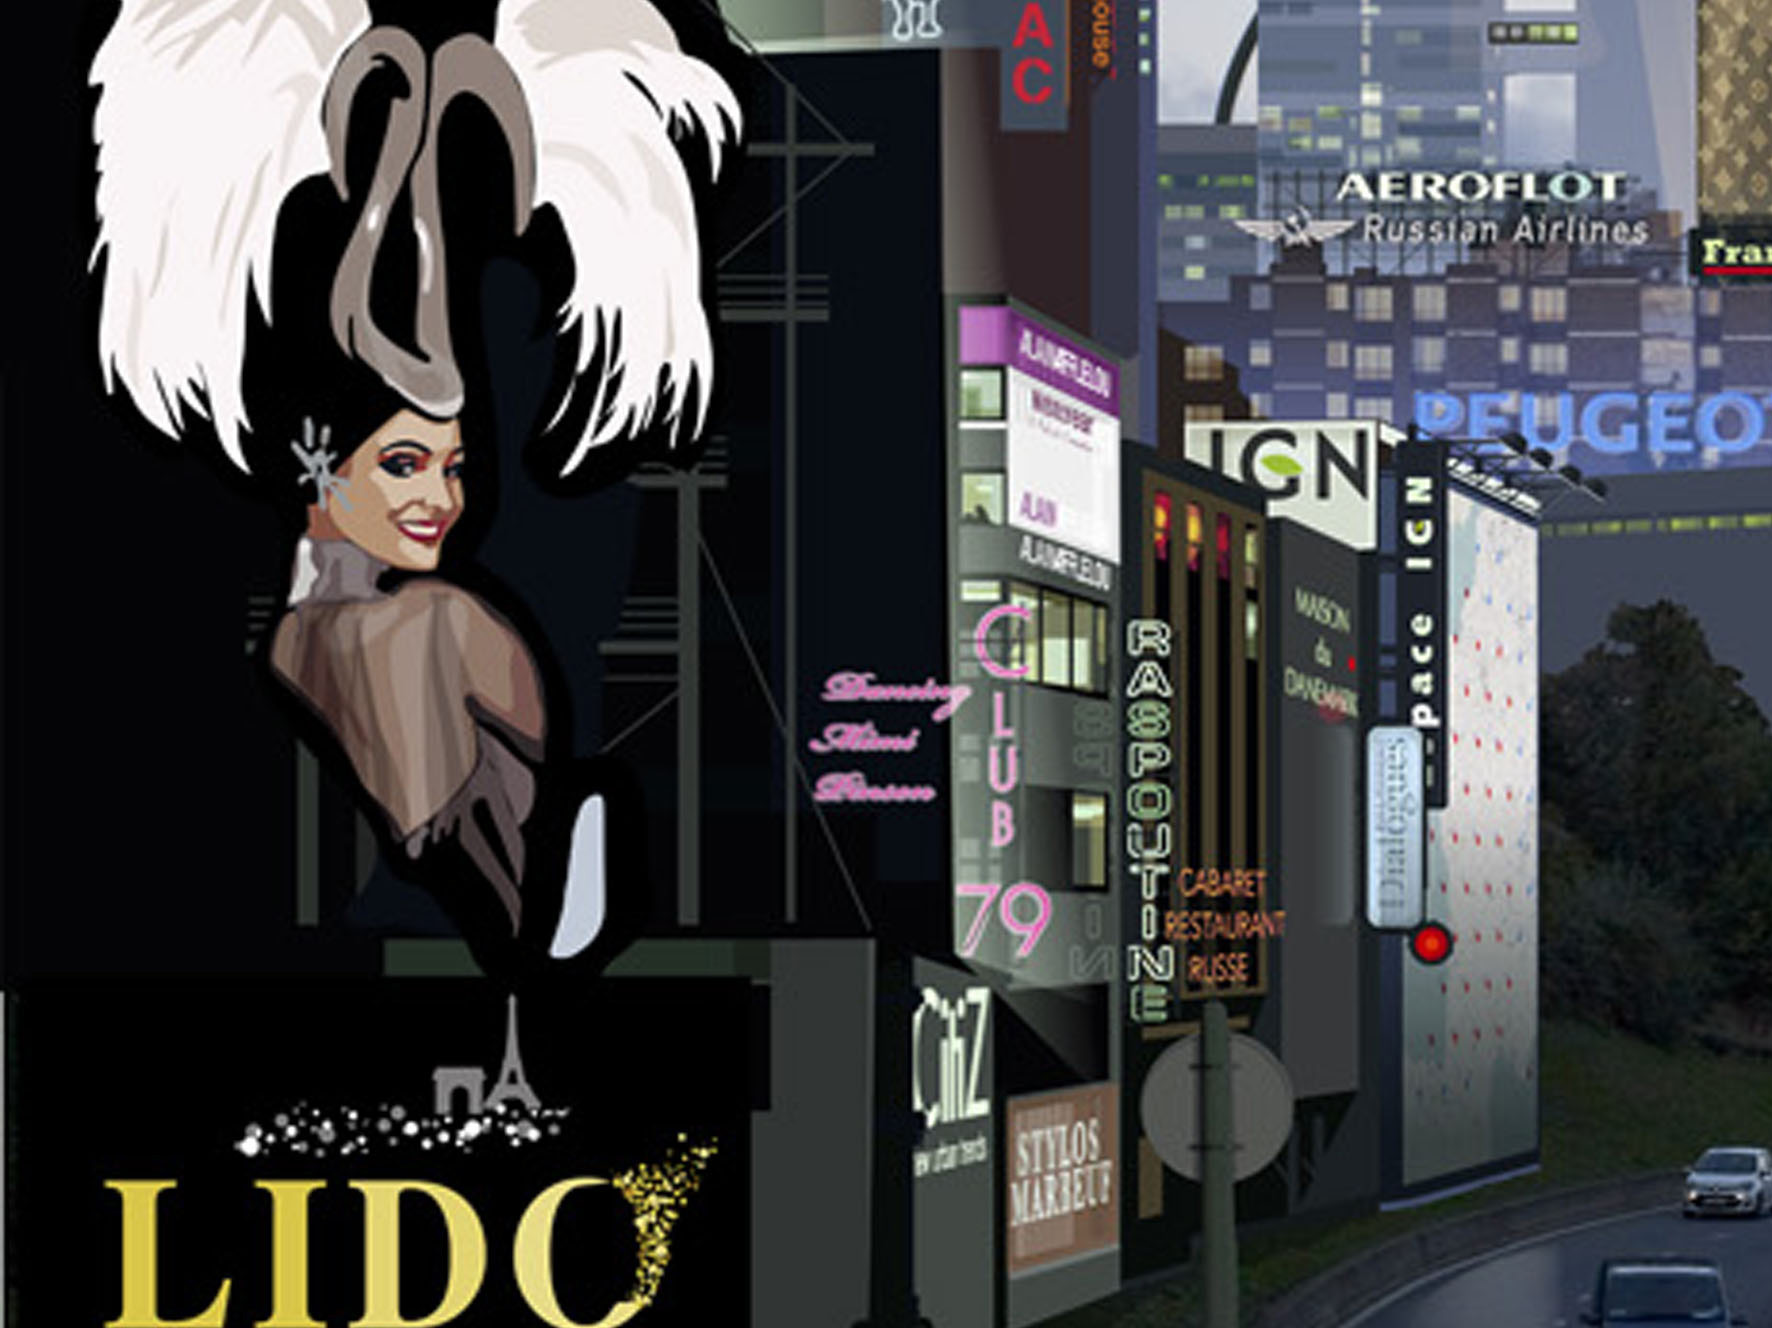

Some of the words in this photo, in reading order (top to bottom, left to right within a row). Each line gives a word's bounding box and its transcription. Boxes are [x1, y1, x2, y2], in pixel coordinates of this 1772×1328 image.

[1336, 170, 1628, 202] AEROFLOT
[1362, 212, 1499, 244] Russian
[1513, 213, 1650, 246] Airlines
[1210, 428, 1370, 501] IGN
[1404, 476, 1433, 570] IGN
[1295, 587, 1351, 633] MAISON
[820, 672, 972, 721] Dancing
[974, 604, 1032, 848] CLUB
[1126, 619, 1174, 1025] RASPOUTINE
[1178, 869, 1268, 900] CABARET
[955, 882, 1053, 958] 79
[1163, 908, 1287, 942] RESTAURANT
[1188, 951, 1250, 984] RUSSE
[1016, 1116, 1100, 1178] STYLOS
